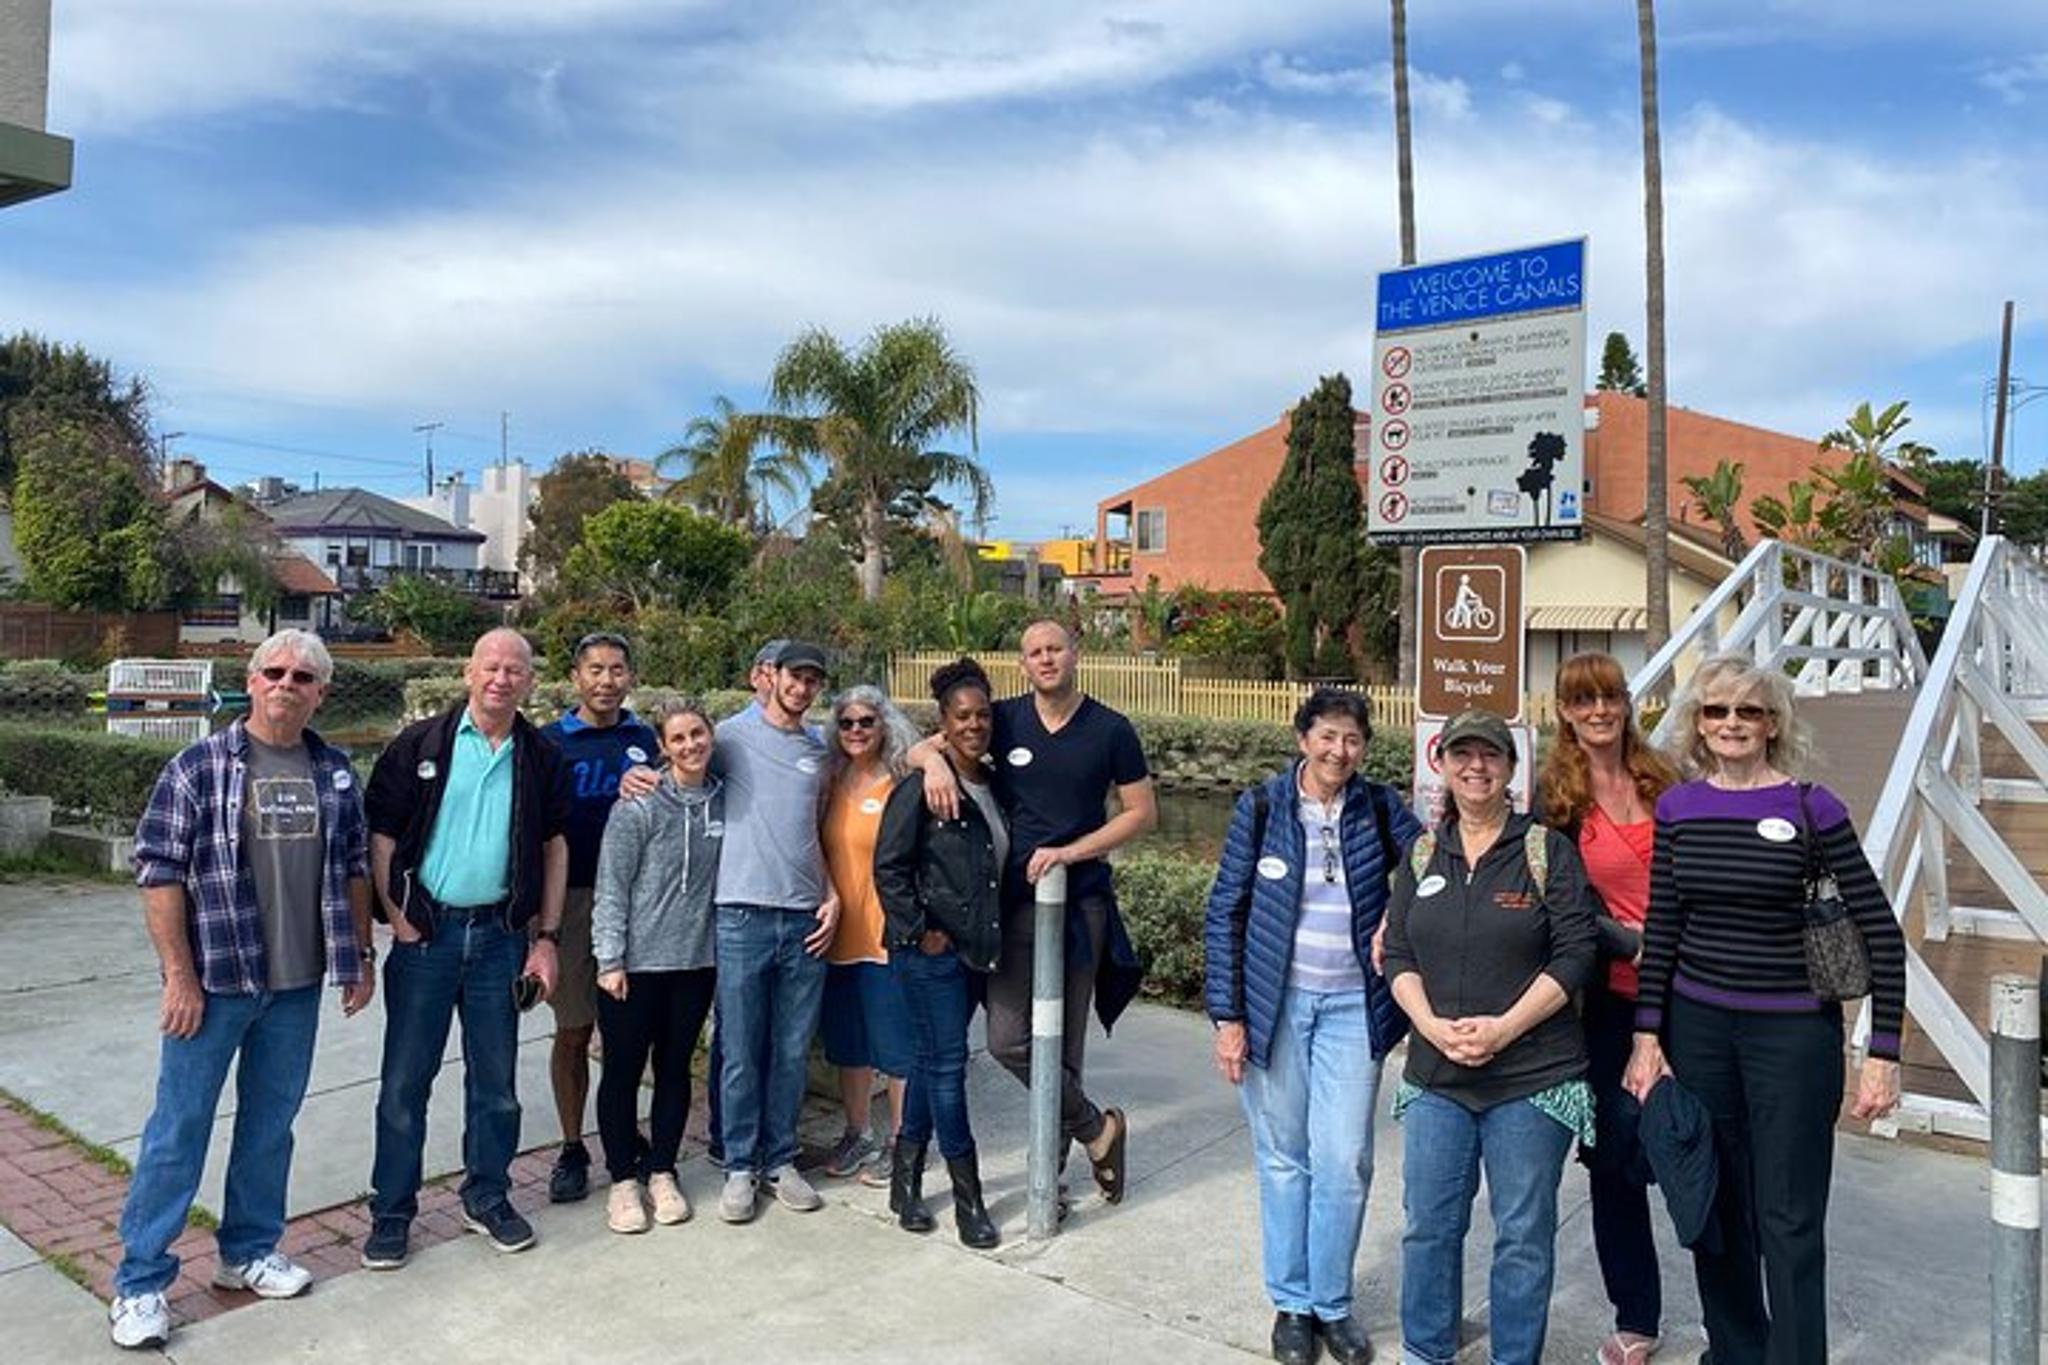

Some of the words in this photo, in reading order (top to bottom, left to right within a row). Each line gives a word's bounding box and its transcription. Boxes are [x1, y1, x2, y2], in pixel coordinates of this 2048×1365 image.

[1408, 260, 1512, 296] WELCOME
[1520, 255, 1549, 279] TO
[1381, 298, 1413, 321] THE
[1418, 287, 1489, 317] VENICE
[1496, 273, 1580, 305] CANALS
[1432, 658, 1469, 673] Walk
[1473, 659, 1506, 675] Your
[1444, 678, 1494, 698] Bicycle
